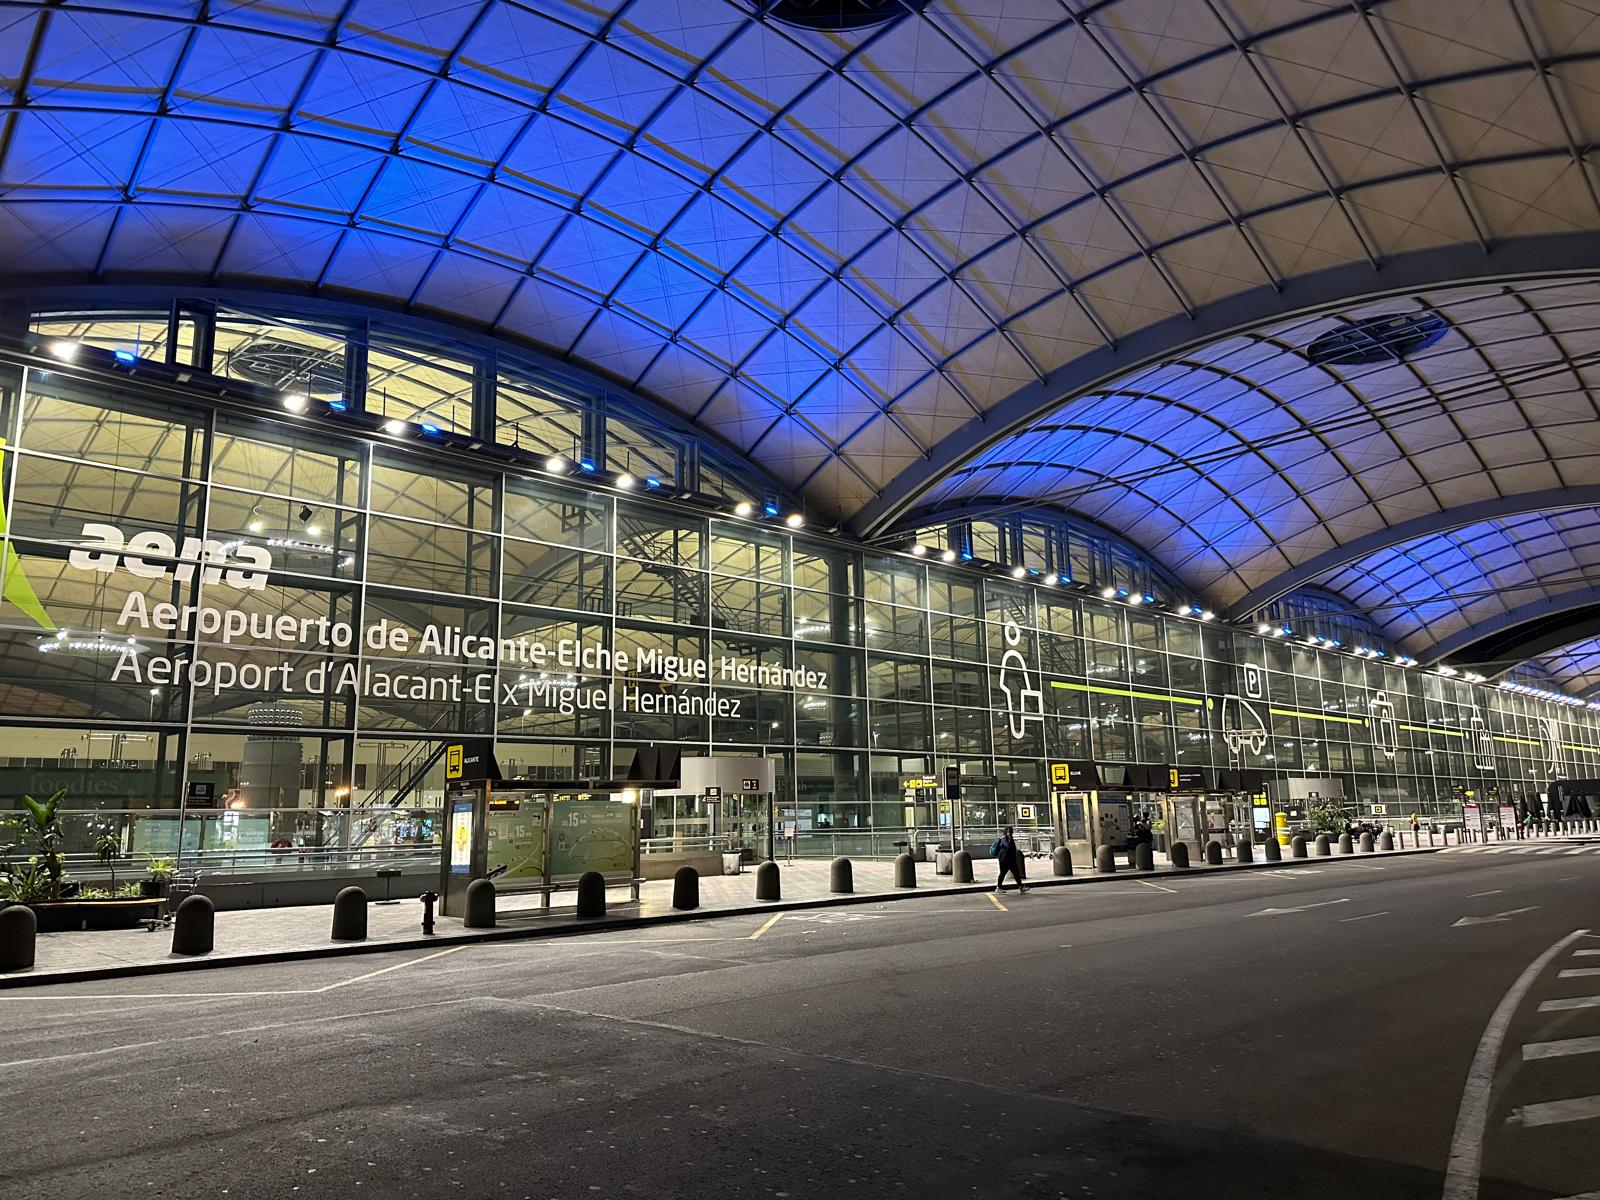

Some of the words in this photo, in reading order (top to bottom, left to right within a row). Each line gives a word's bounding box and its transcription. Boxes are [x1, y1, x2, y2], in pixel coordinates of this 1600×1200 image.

[69, 523, 272, 591] aena
[117, 591, 354, 647] Aeropuerto
[365, 618, 410, 653] de
[418, 624, 630, 673] Alicante-Elche
[636, 647, 711, 682] Miguel
[720, 655, 828, 691] Hernández
[111, 650, 295, 696] Aeroport
[528, 678, 612, 715] Miguel
[623, 684, 741, 719] Hernández
[1248, 670, 1257, 691] P
